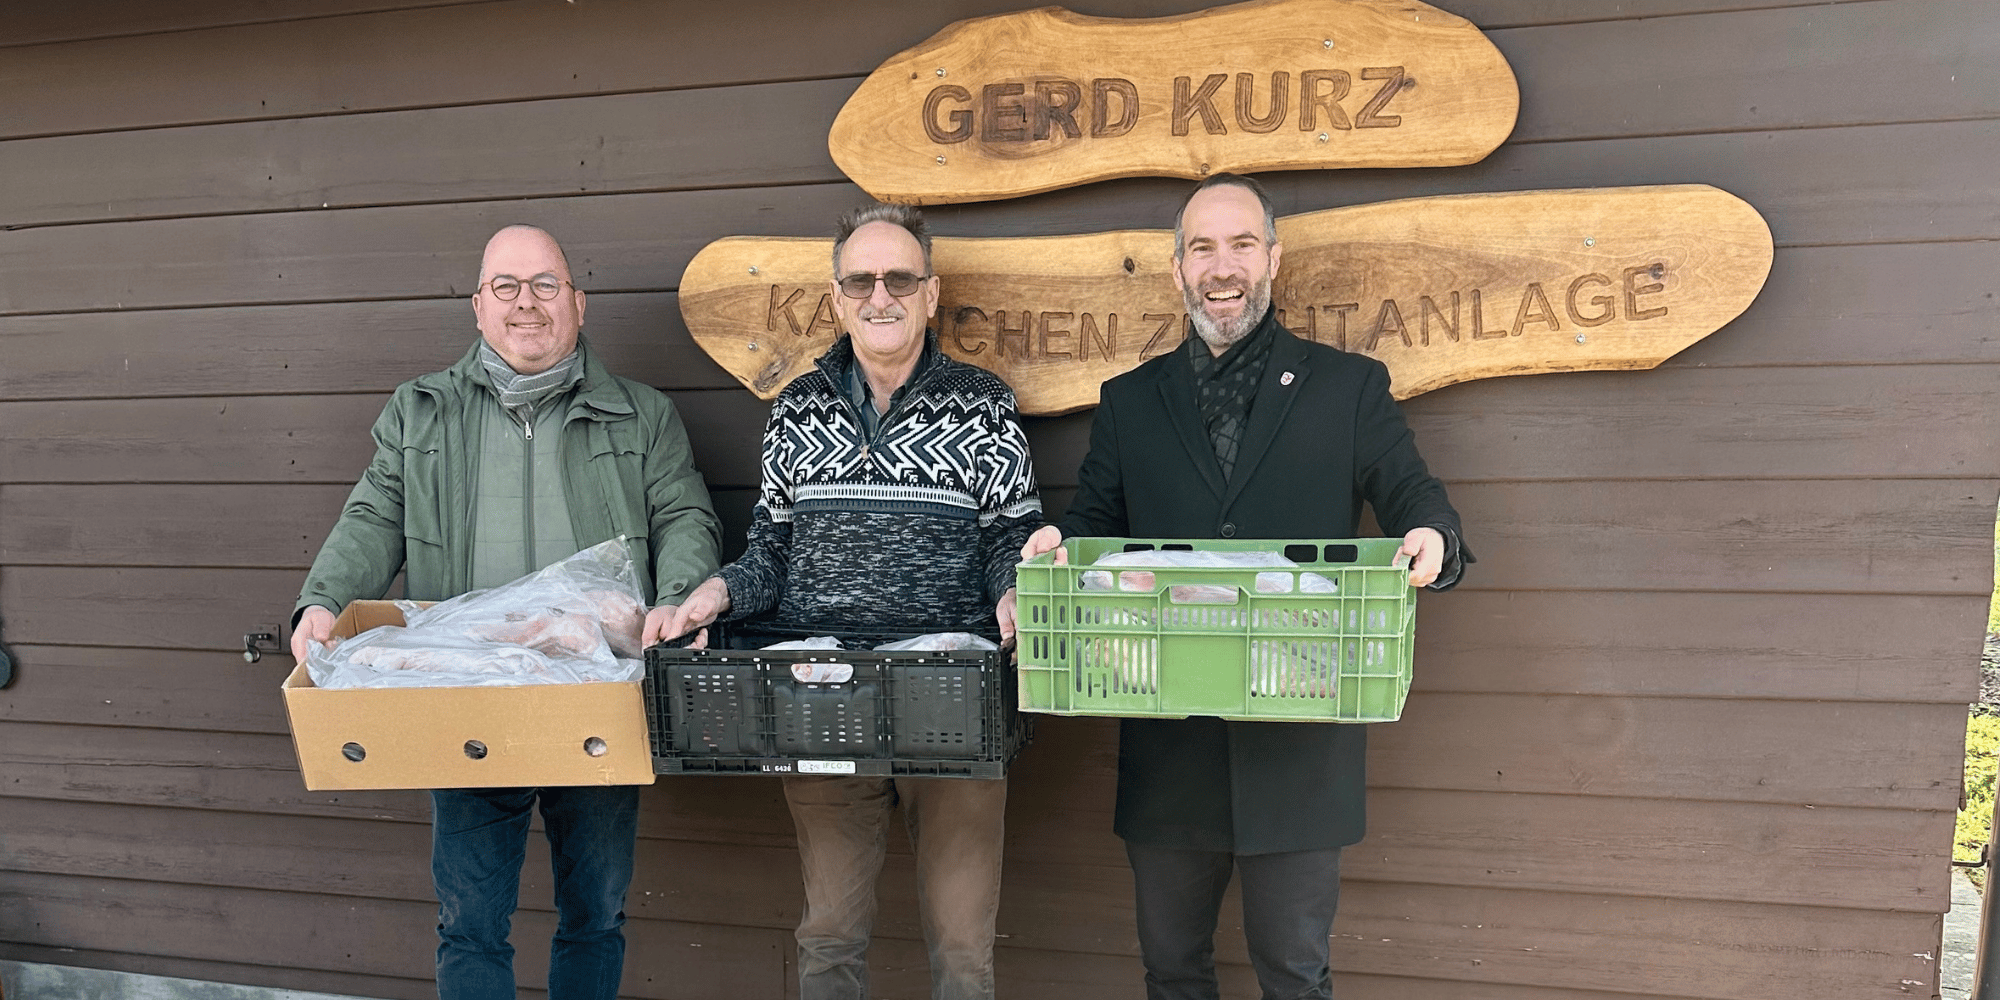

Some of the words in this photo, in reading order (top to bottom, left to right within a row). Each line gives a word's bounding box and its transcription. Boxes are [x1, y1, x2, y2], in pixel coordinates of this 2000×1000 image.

[923, 77, 1140, 144] GERD
[1171, 65, 1405, 136] KURZ
[766, 283, 1116, 363] KACHEN
[1139, 265, 1669, 362] ZHTANLAGE
[822, 762, 843, 770] IFCO
